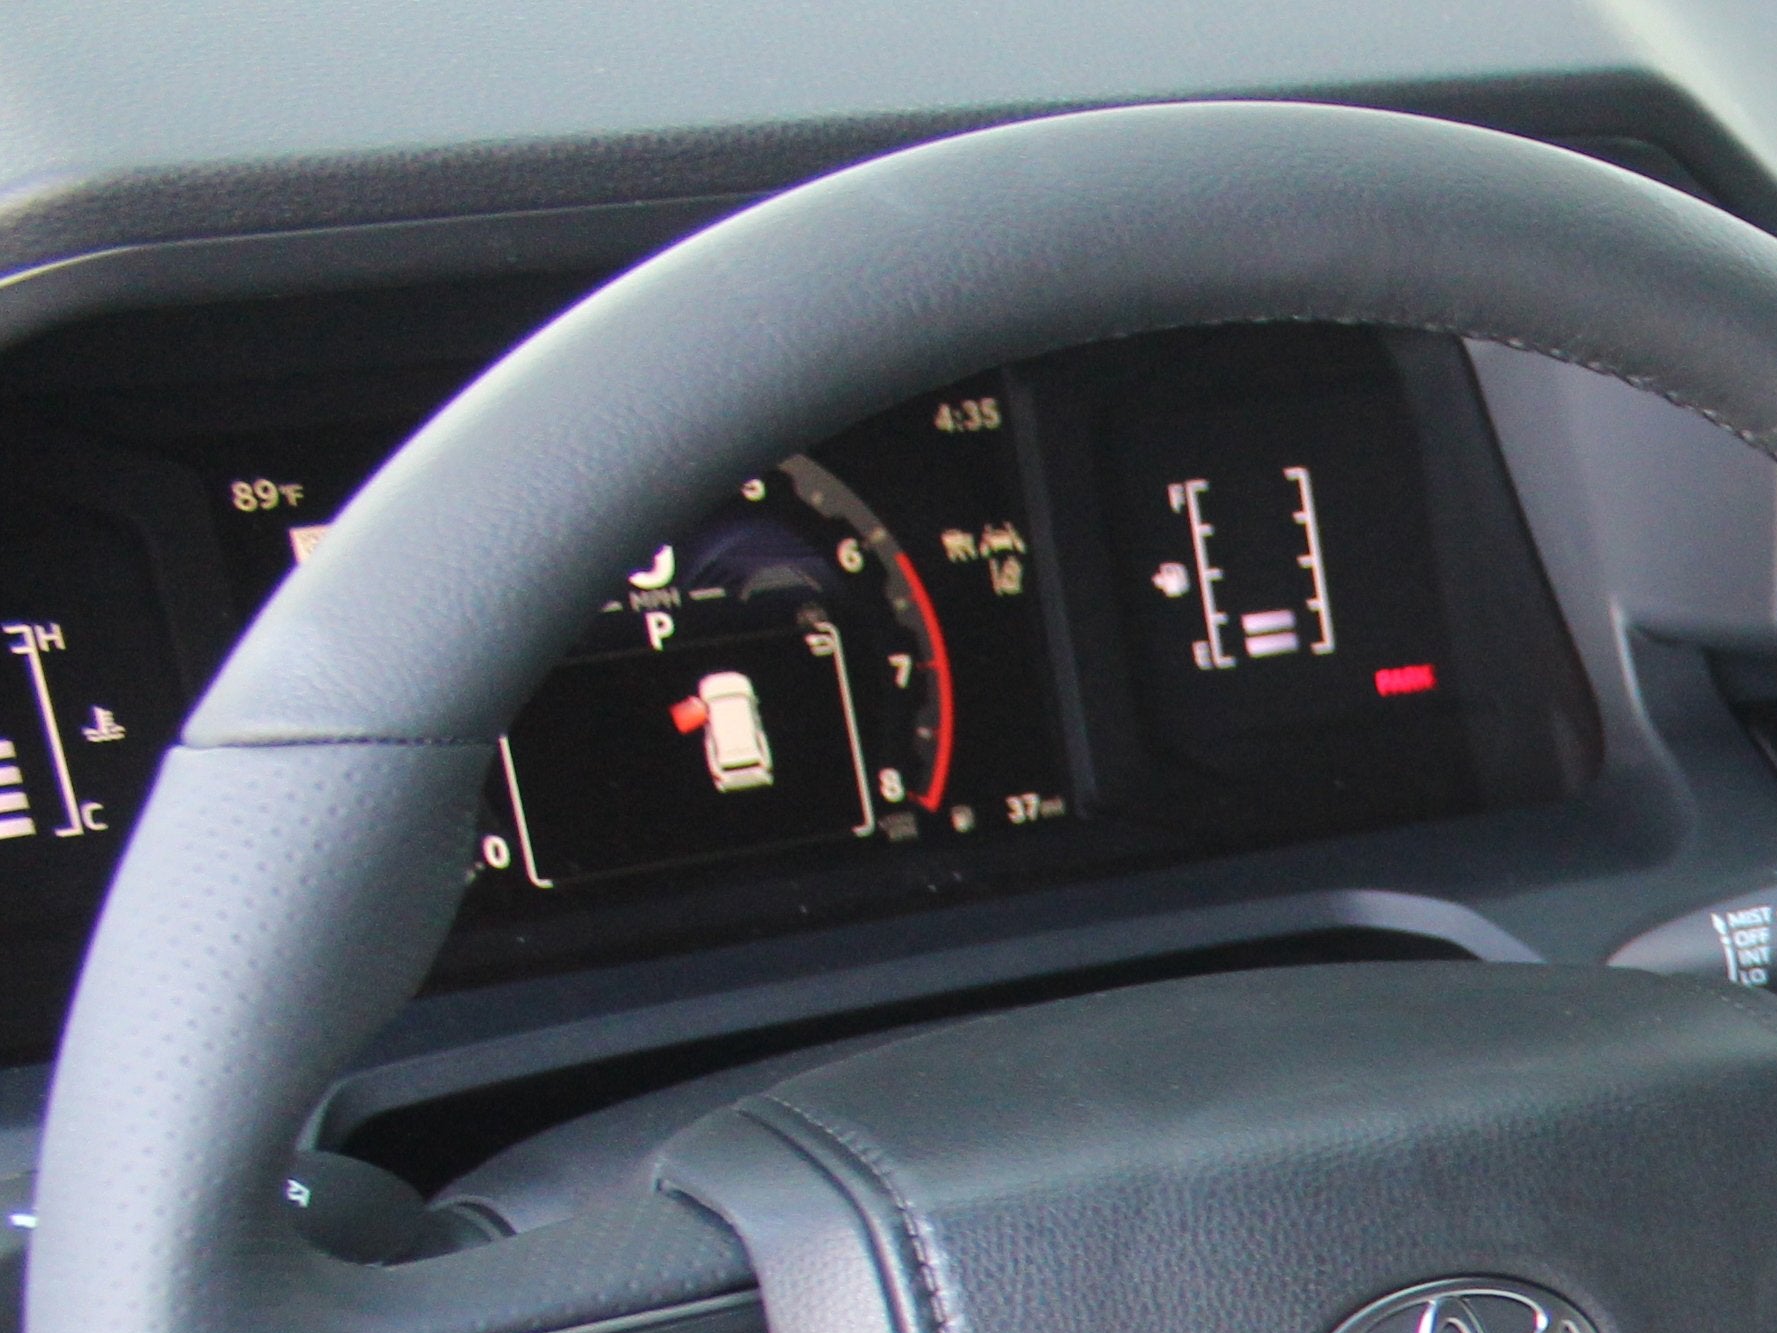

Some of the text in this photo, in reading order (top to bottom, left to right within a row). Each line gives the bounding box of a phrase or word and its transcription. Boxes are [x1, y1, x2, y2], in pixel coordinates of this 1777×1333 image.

[934, 397, 1001, 432] 4:35
[836, 537, 864, 573] 6
[36, 623, 66, 652] H
[645, 611, 674, 651] P
[887, 654, 911, 688] 7
[878, 767, 904, 803] 8
[1727, 906, 1772, 928] MIST
[1734, 927, 1770, 948] OFF
[1738, 946, 1771, 966] INT
